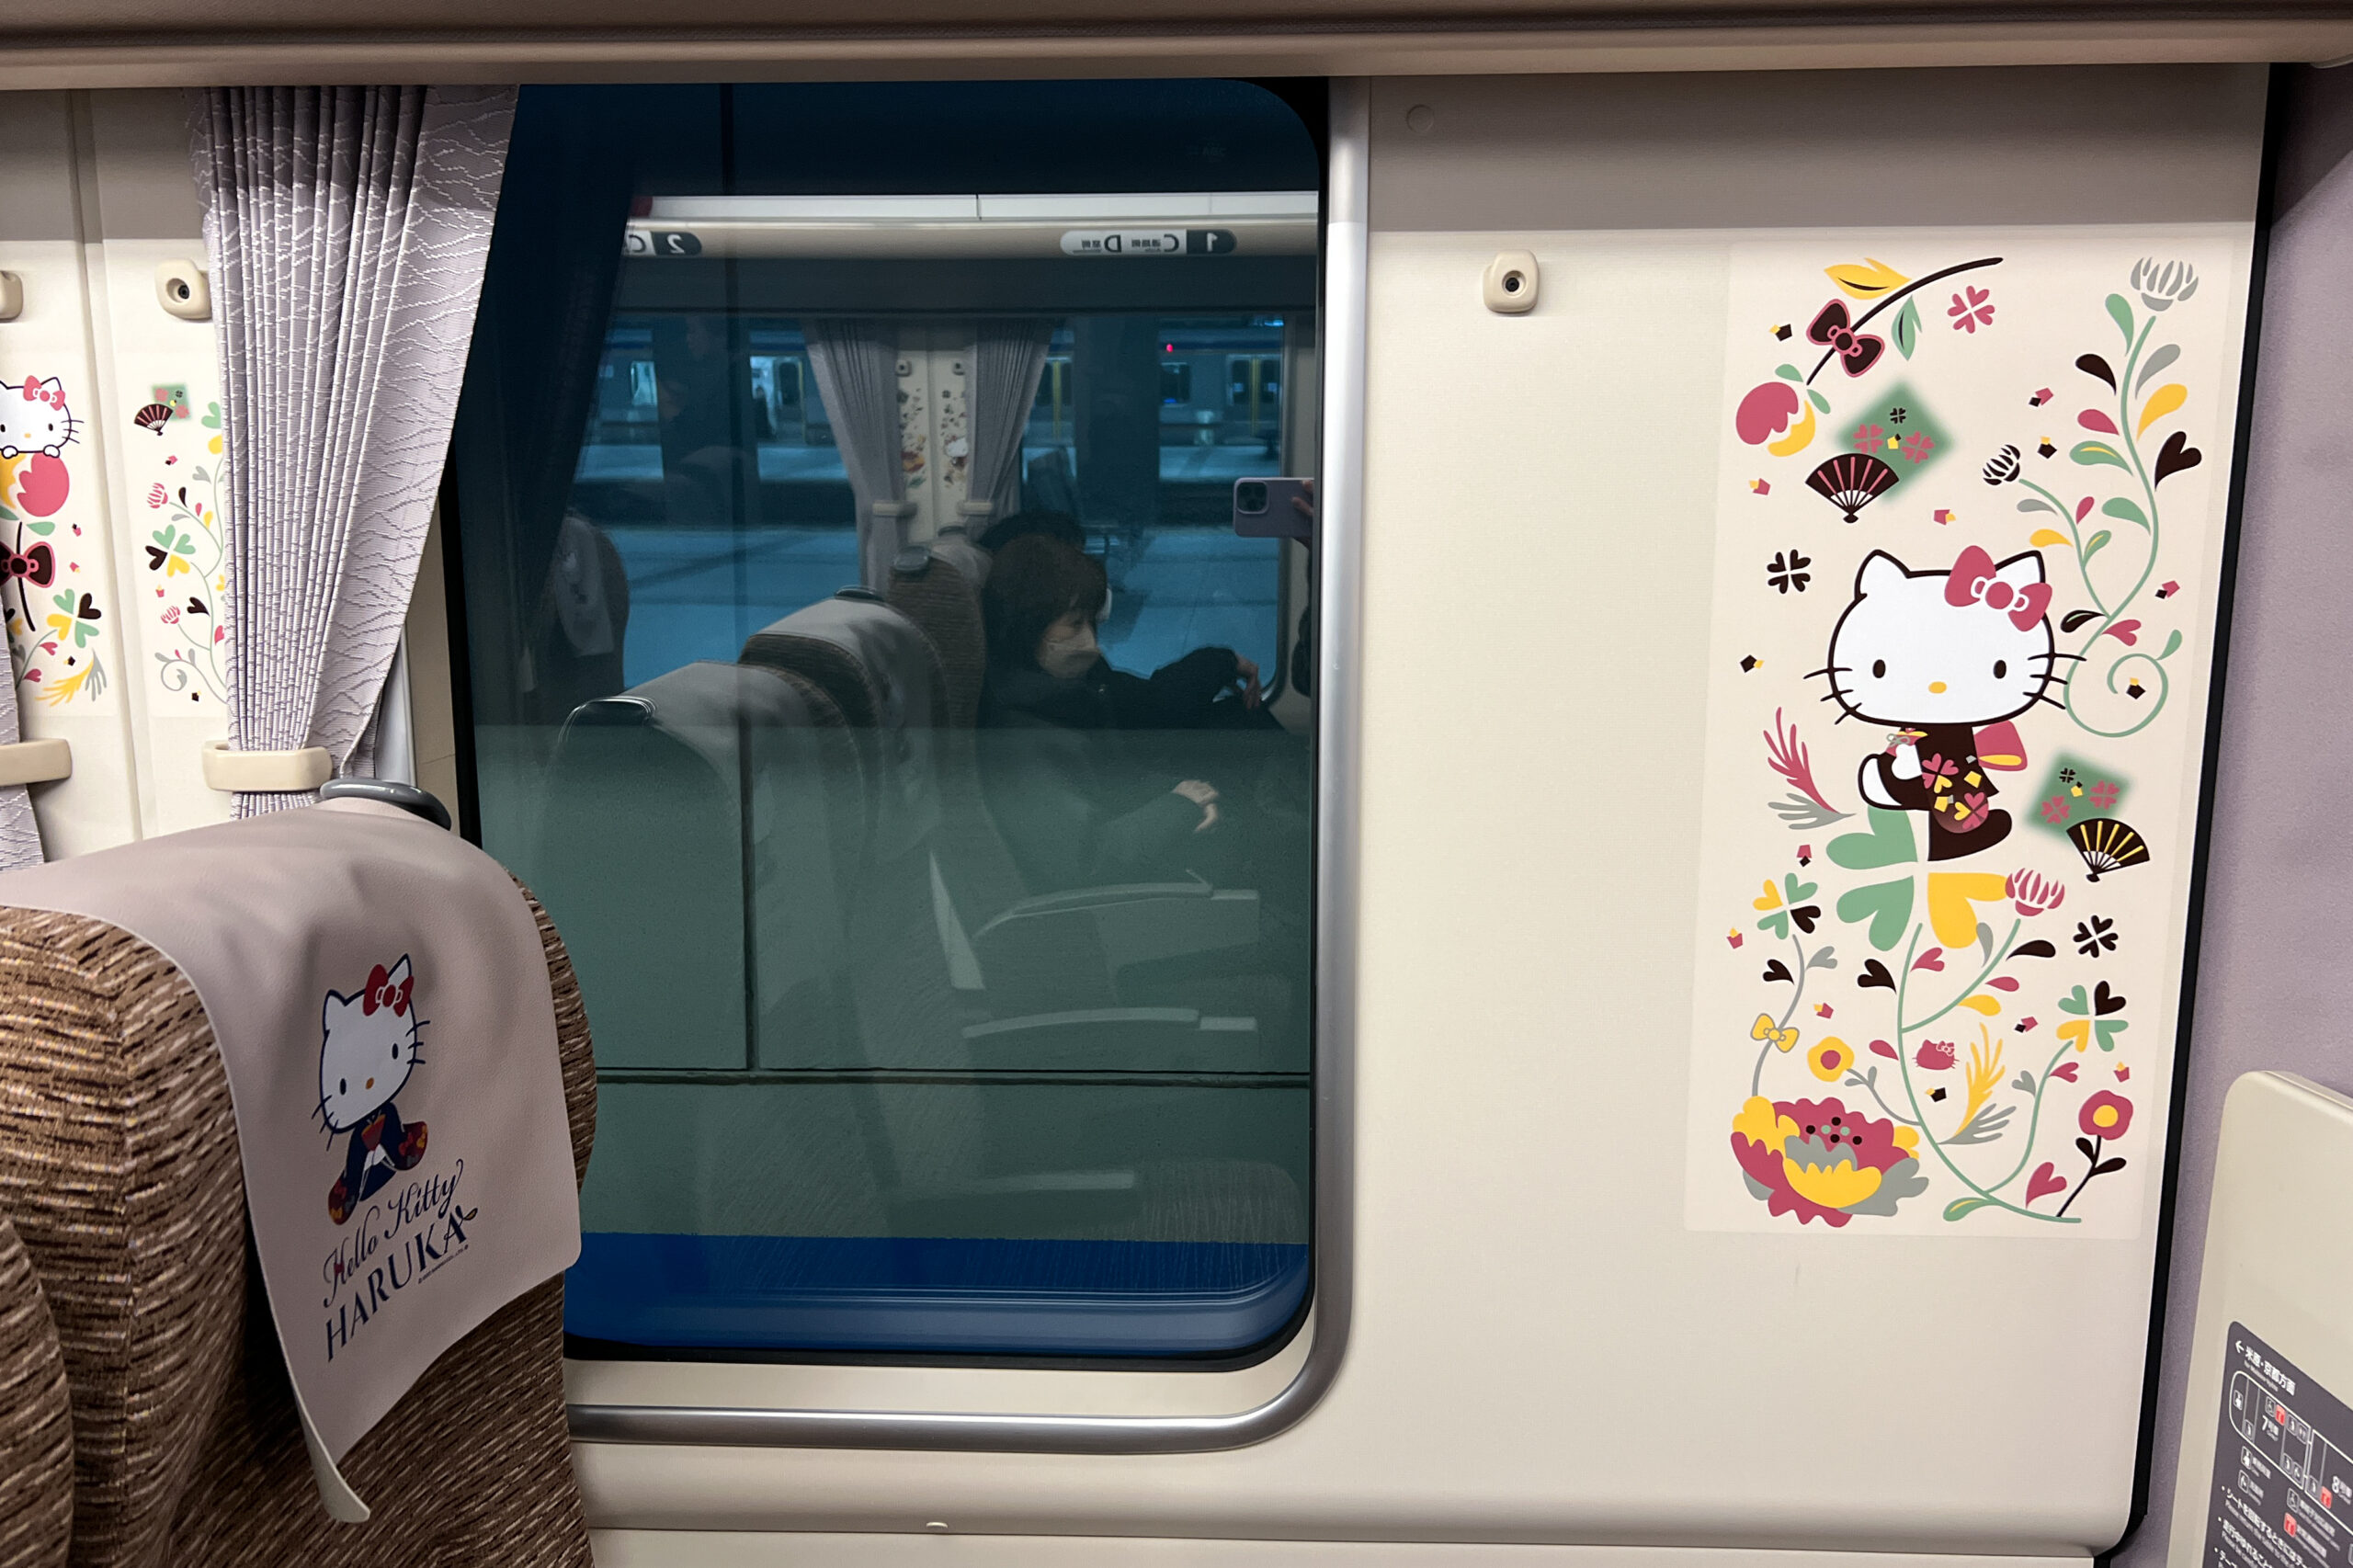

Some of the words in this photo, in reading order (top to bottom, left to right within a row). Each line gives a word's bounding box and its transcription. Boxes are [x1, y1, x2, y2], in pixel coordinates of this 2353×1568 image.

[324, 1205, 381, 1308] Hello
[384, 1158, 464, 1240] Kitty
[325, 1205, 479, 1363] HARUKA
